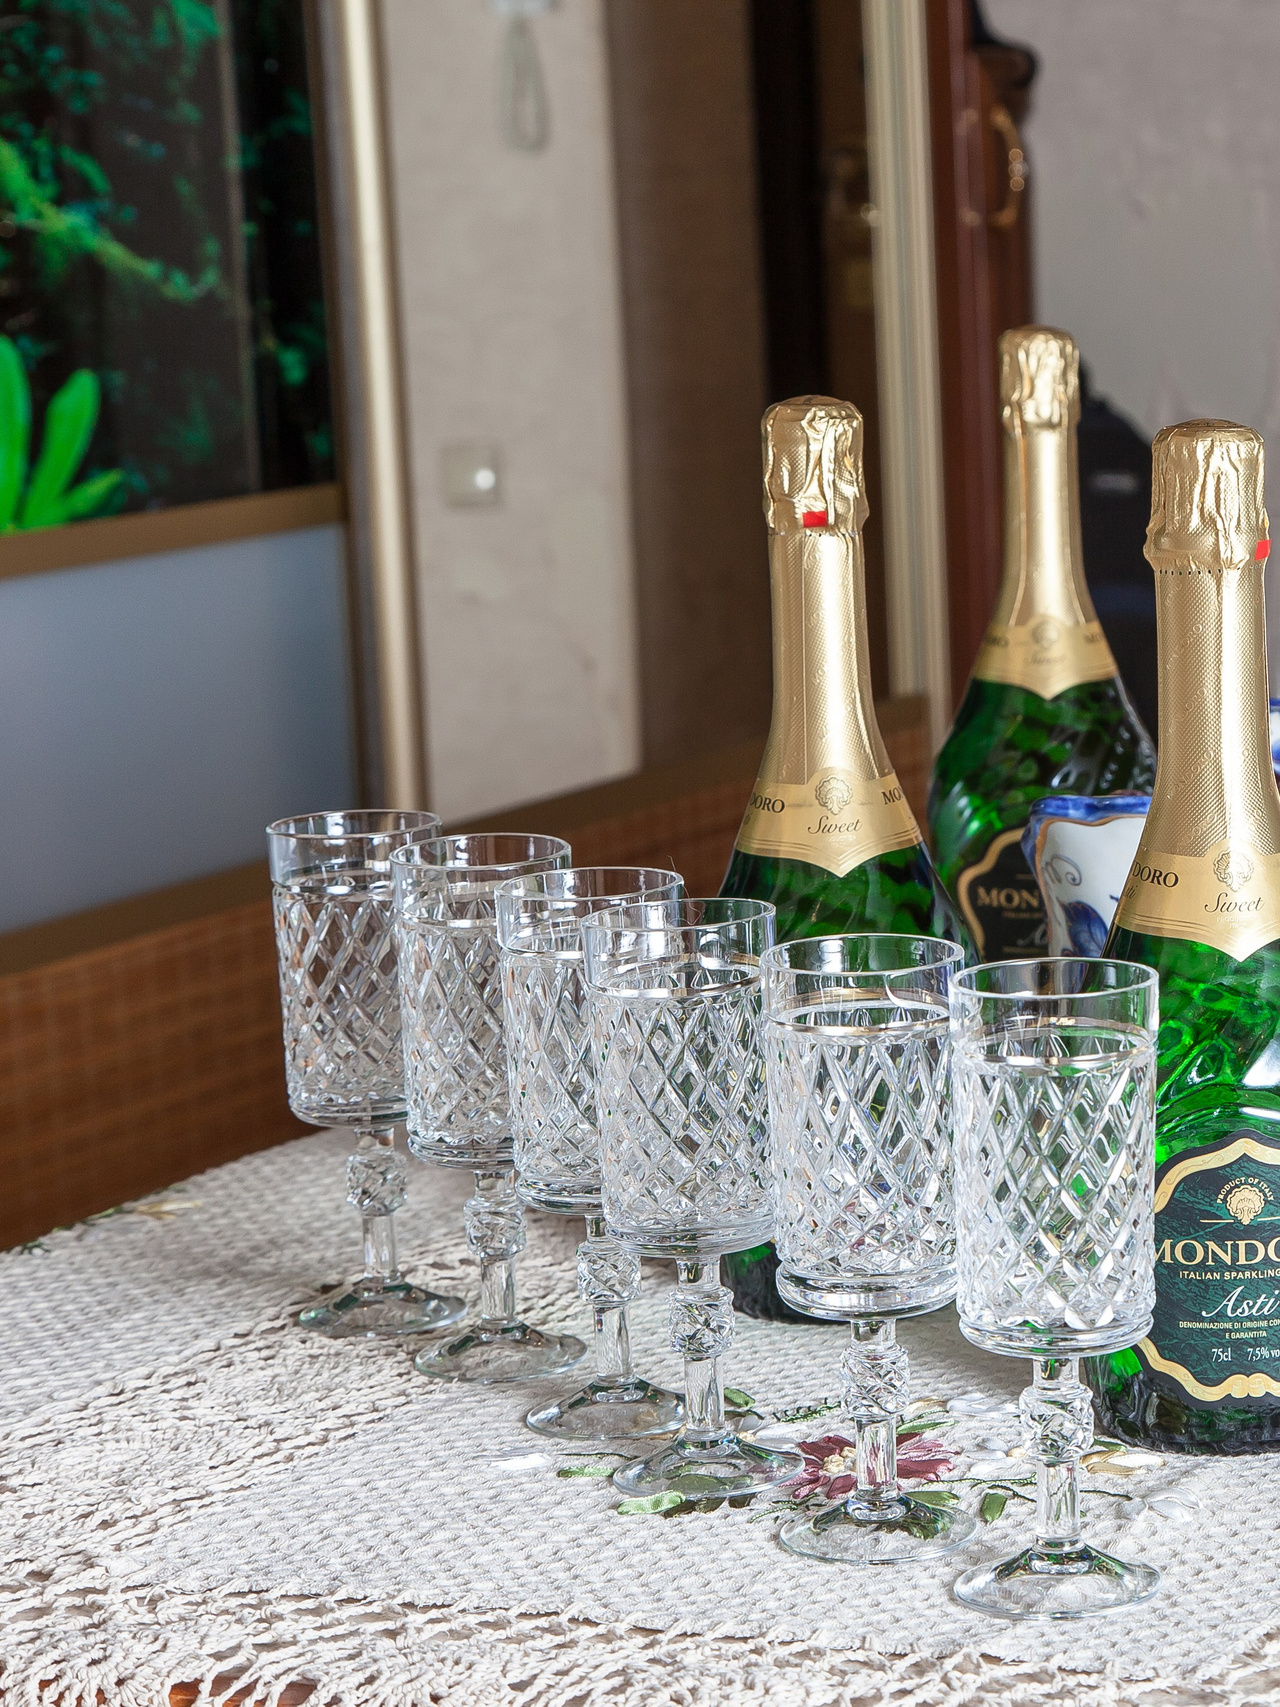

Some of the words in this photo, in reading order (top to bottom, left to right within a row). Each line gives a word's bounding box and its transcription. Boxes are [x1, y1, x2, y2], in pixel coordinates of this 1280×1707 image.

[807, 815, 864, 835] Sweet
[1203, 891, 1266, 913] Sweet
[1216, 1177, 1246, 1204] PRODUCT
[1247, 1177, 1259, 1185] OF
[1258, 1181, 1274, 1201] ITALY
[1179, 1270, 1221, 1280] ITALIAN
[1201, 1285, 1280, 1318] Asti
[1179, 1321, 1233, 1329] DENOMINAZIONE
[1242, 1320, 1268, 1329] ORIGINE
[1231, 1330, 1268, 1339] GARANTITA
[1211, 1347, 1232, 1362] 75cl
[1247, 1346, 1270, 1361] 7,5%
